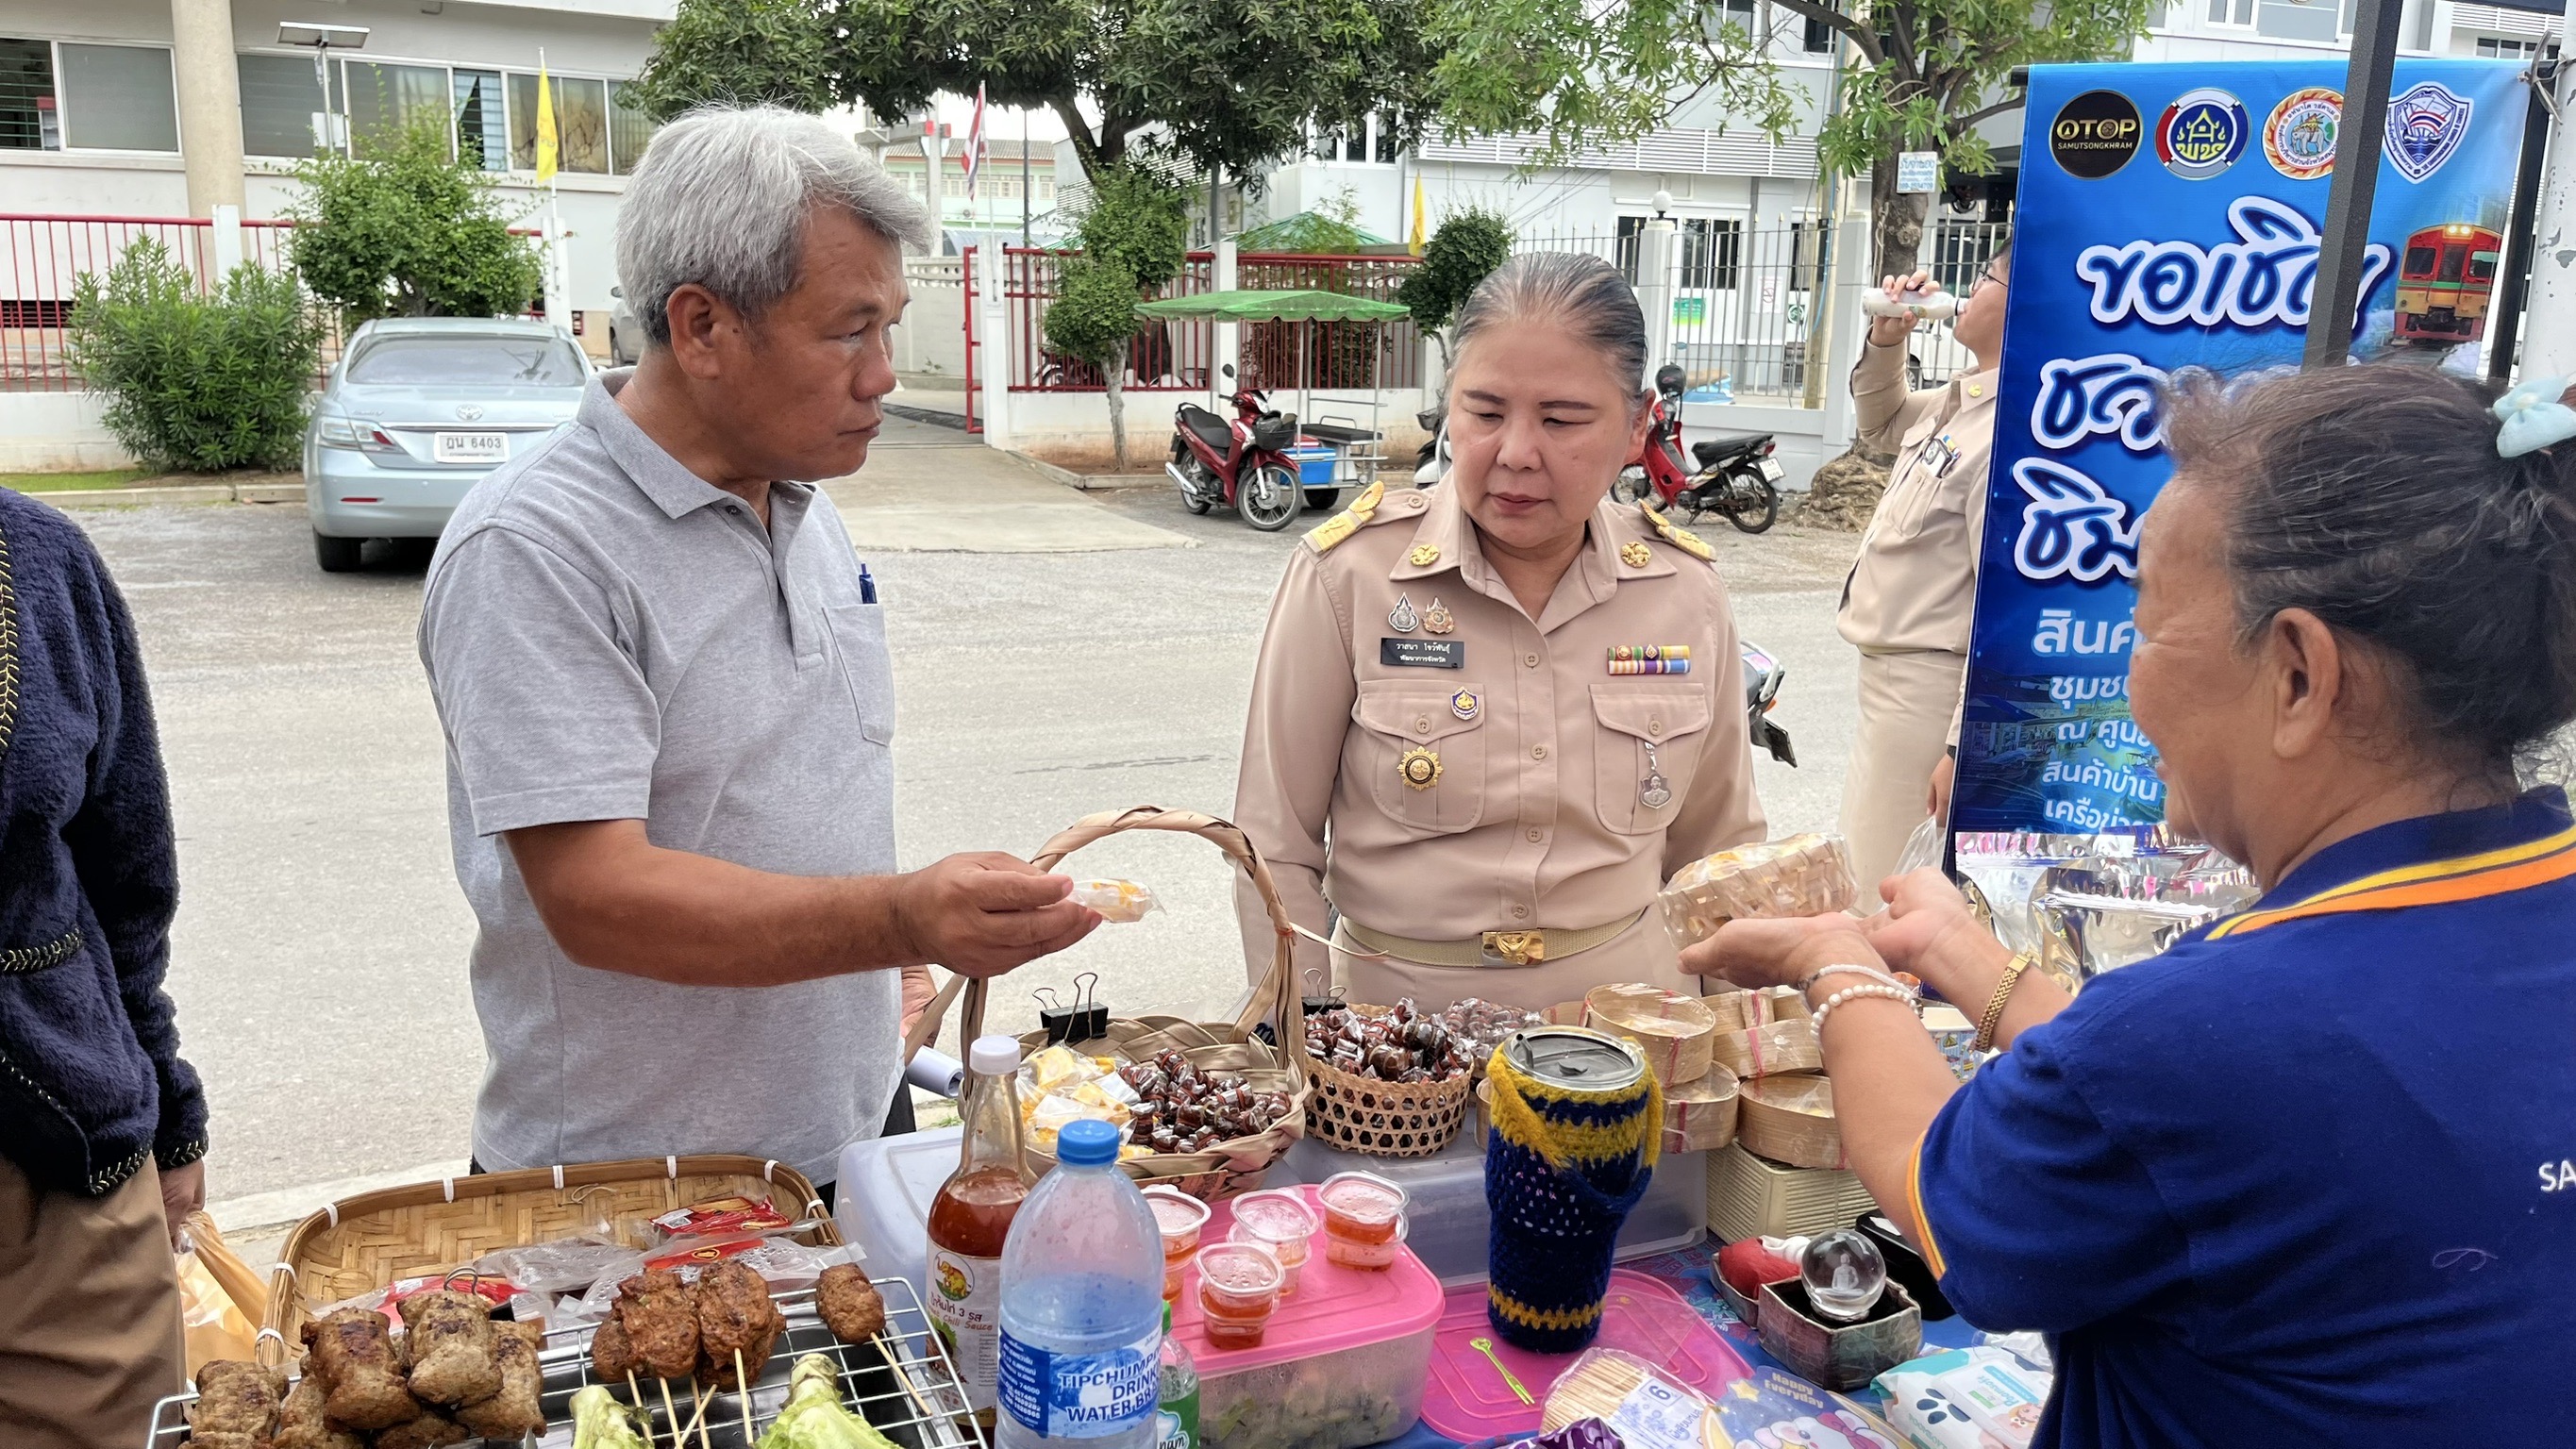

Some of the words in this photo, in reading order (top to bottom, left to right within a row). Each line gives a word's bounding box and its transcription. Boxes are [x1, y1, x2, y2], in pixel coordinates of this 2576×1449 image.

[2056, 119, 2137, 140] OTOP
[2057, 142, 2133, 151] SAMUTSONGKHRAM
[471, 437, 502, 449] 6403
[2057, 722, 2087, 741] ณ
[2042, 758, 2158, 802] สินค้าบ้าน
[959, 1307, 965, 1318] 3
[968, 1312, 983, 1323] รส
[964, 1321, 994, 1331] Sauce
[1112, 1366, 1159, 1401] DRINK
[1648, 1385, 1672, 1401] 6
[1772, 1372, 1815, 1395] Happy
[1765, 1380, 1825, 1409] Everyday
[1066, 1398, 1131, 1423] WATER
